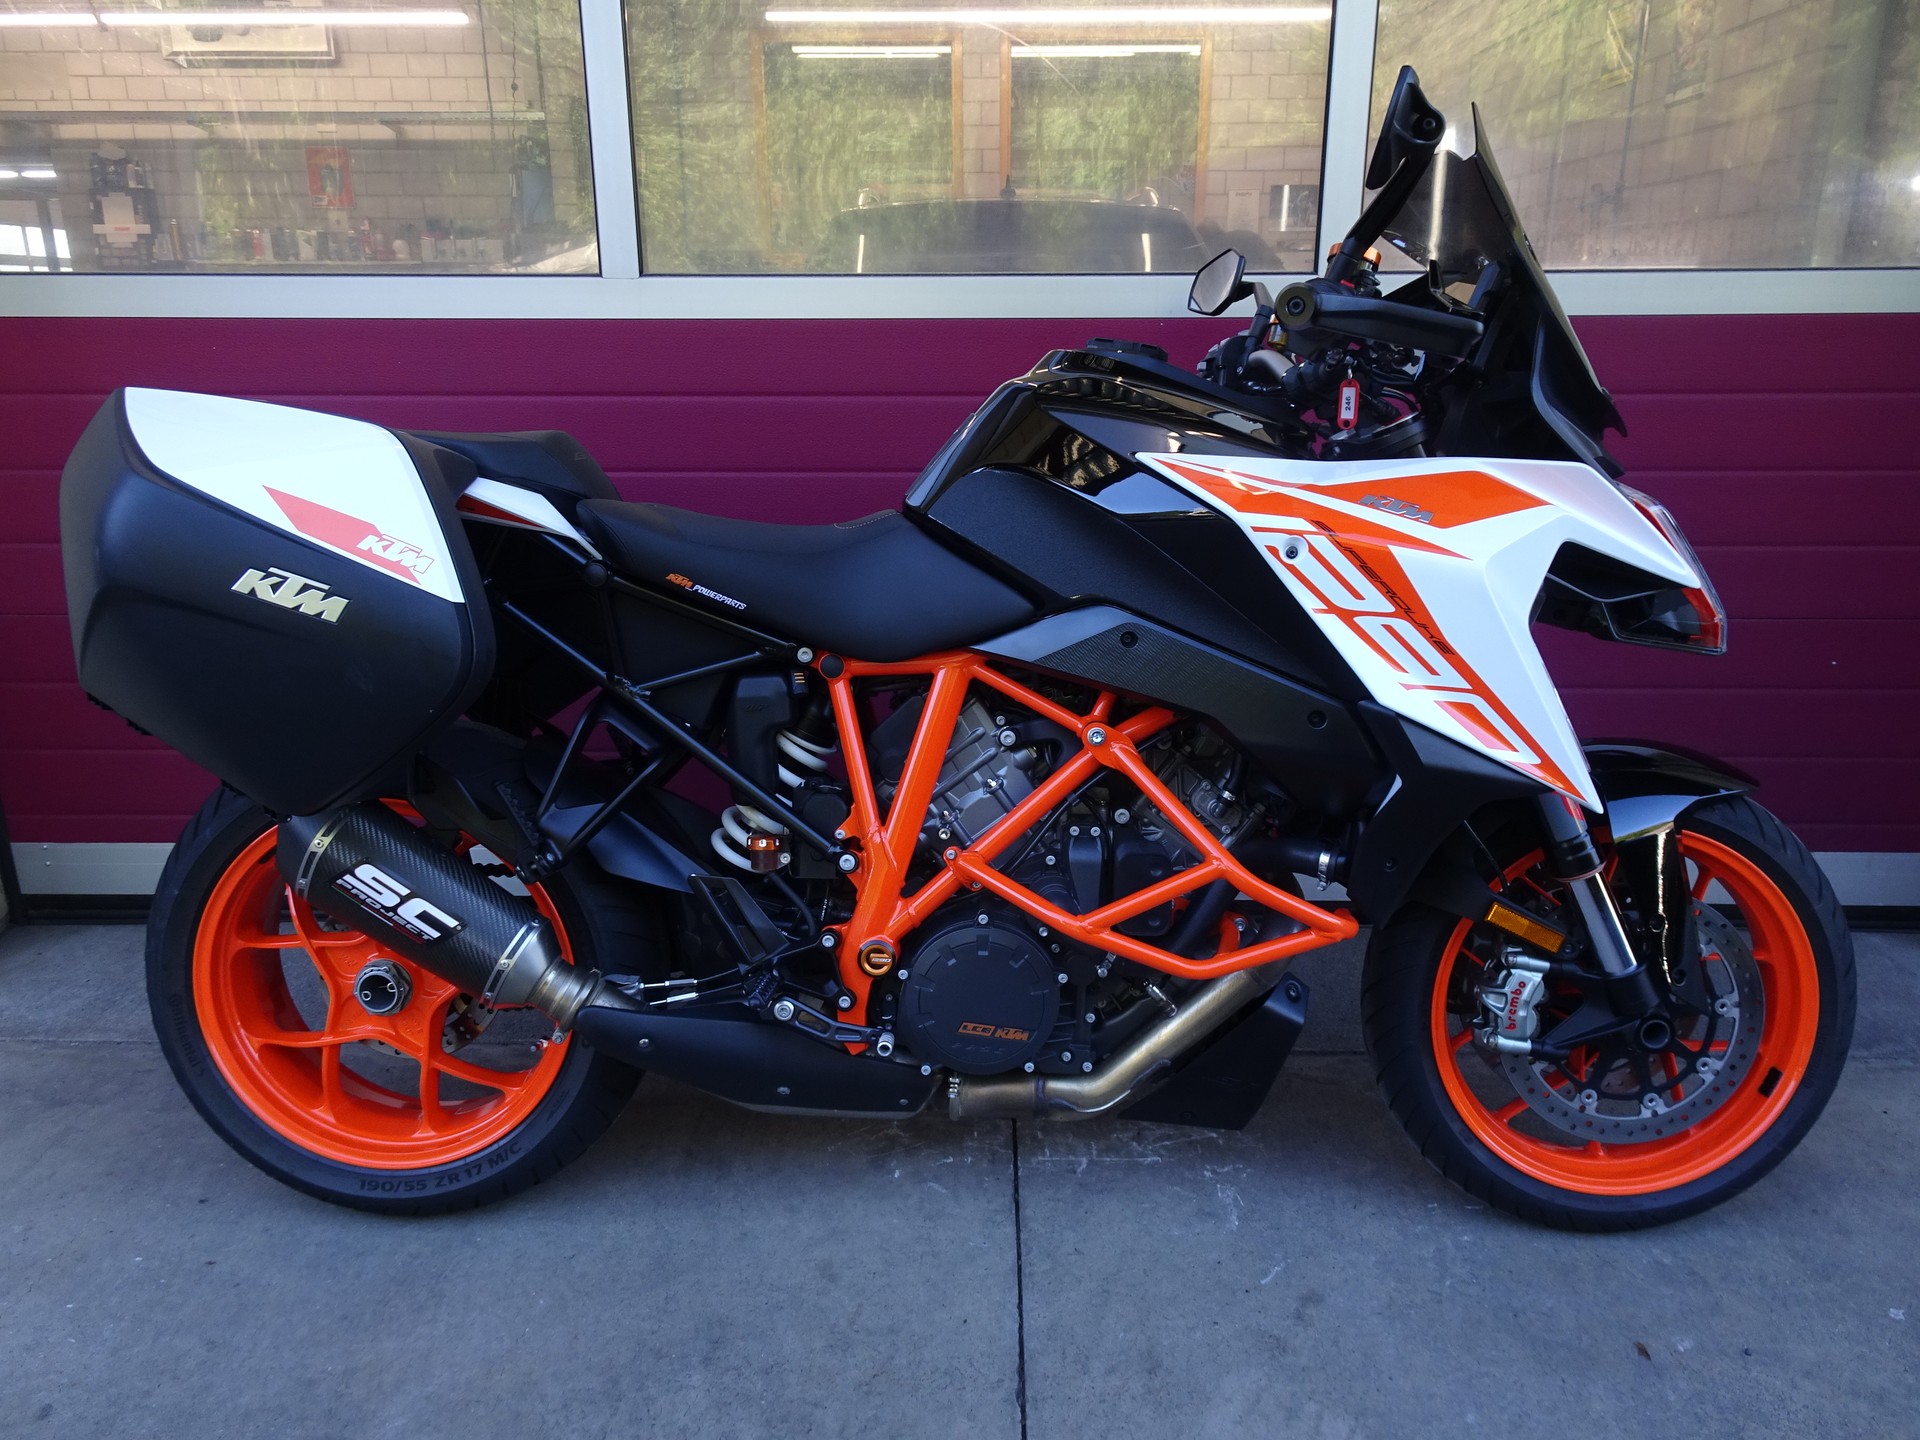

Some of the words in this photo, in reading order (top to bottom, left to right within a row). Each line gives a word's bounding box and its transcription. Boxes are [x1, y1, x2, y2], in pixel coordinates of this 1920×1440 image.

[1344, 396, 1352, 411] 246
[1359, 494, 1434, 524] KTM
[356, 534, 435, 575] KTM
[231, 567, 351, 625] KTM
[335, 878, 434, 941] PROJECT
[341, 863, 461, 939] SC
[1505, 981, 1526, 1031] brembo
[995, 1027, 1029, 1041] KTM
[358, 1178, 428, 1193] 190/55
[434, 1171, 461, 1189] ZR
[464, 1164, 483, 1180] 17
[488, 1141, 523, 1170] M/C
